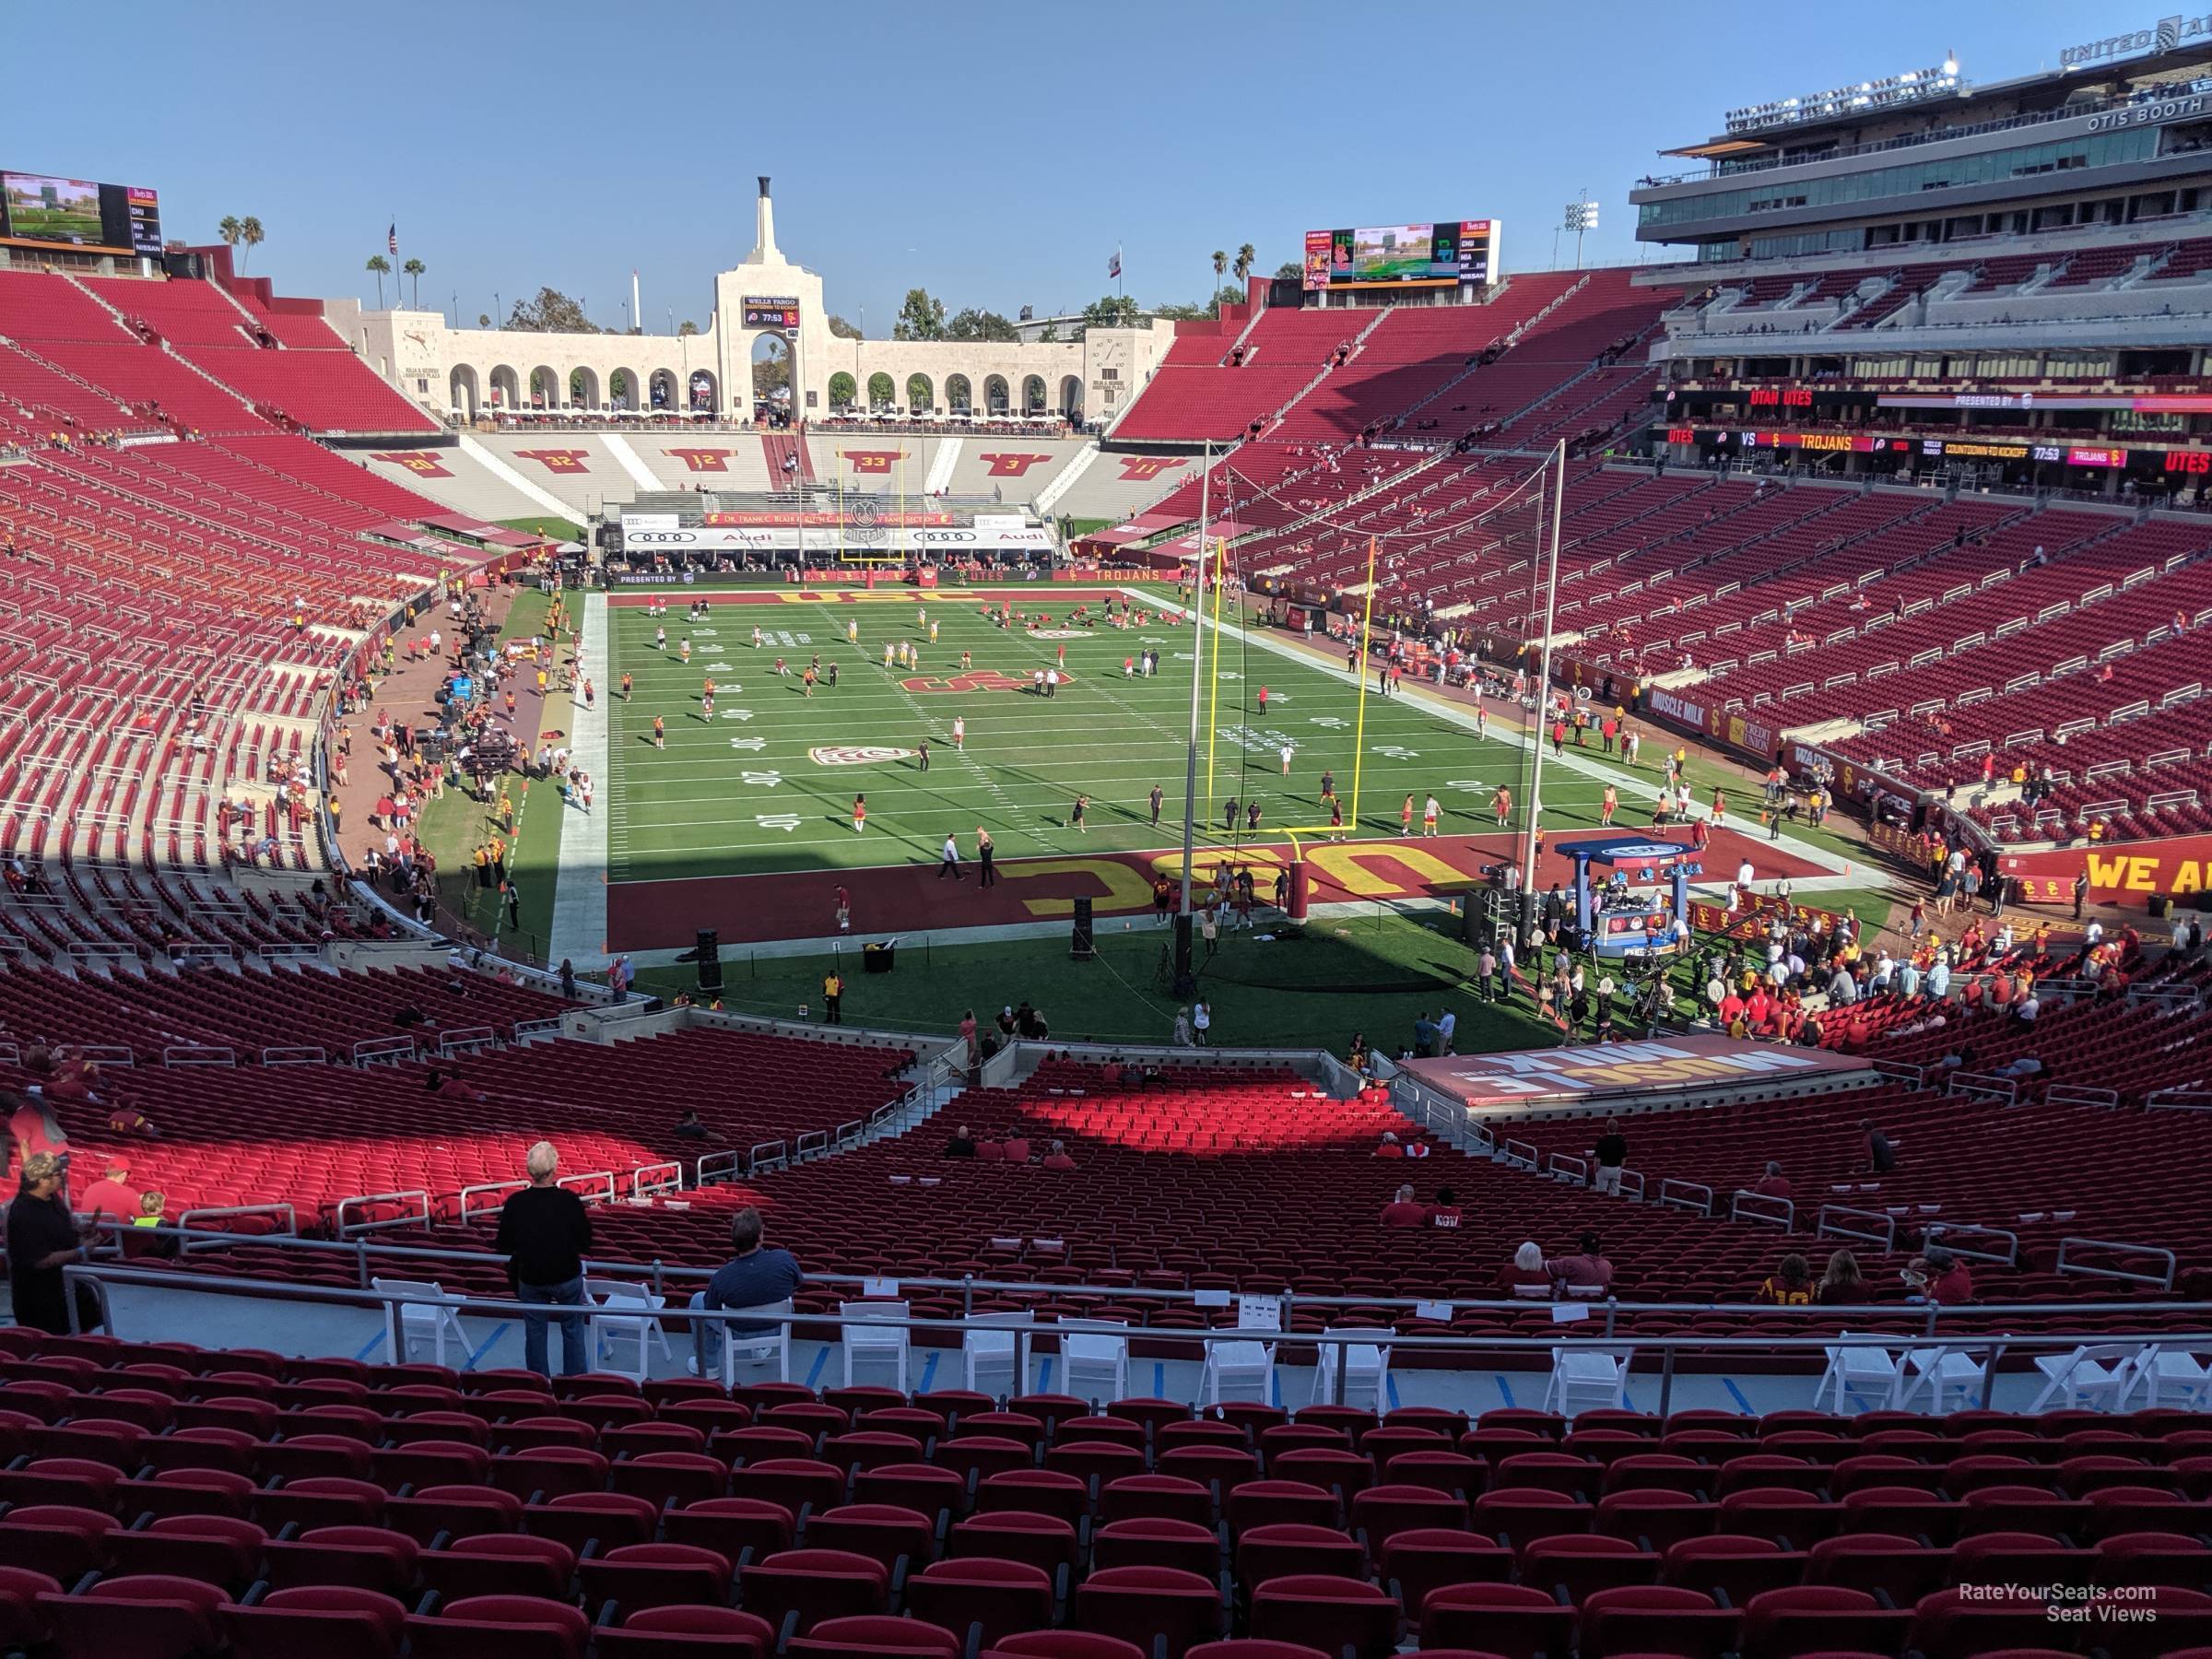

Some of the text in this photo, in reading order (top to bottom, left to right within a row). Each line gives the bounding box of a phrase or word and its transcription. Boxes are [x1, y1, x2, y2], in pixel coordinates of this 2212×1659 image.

[2060, 29, 2153, 65] UNITED
[2088, 98, 2204, 131] OTIS BOOTH
[135, 244, 161, 253] NISSAN
[762, 313, 782, 322] 77:53
[1750, 390, 1813, 406] UTAH UTES
[1955, 395, 2013, 406] PRESENTED BY
[1668, 429, 1694, 443] UTES
[1742, 432, 1756, 446] VS
[1800, 434, 1853, 452] TROJANS
[1893, 441, 1910, 451] UTES
[1945, 444, 1988, 456] COUNTDOWN
[1998, 446, 2028, 458] KICKOFF
[546, 456, 576, 466] 32
[692, 454, 716, 465] 12
[2033, 447, 2060, 461] 77:53
[2075, 450, 2108, 463] TROJANS
[403, 459, 436, 470] 20
[861, 456, 887, 467] 33
[1006, 460, 1018, 470] 3
[2166, 452, 2211, 474] UTES
[723, 533, 772, 542] Audi
[620, 575, 677, 583] PRESENTED BY
[971, 571, 1004, 581] UTES
[1095, 571, 1159, 581] TROJANS
[776, 592, 986, 603] USC
[1651, 690, 1704, 726] MUSCLE MILK
[1746, 722, 1771, 741] CREDIT
[1744, 734, 1768, 752] UNION
[1000, 843, 1493, 916] USC
[2088, 853, 2212, 894] WE A
[1476, 1042, 1700, 1072] MILK
[1465, 1051, 1819, 1094] MUSCLE
